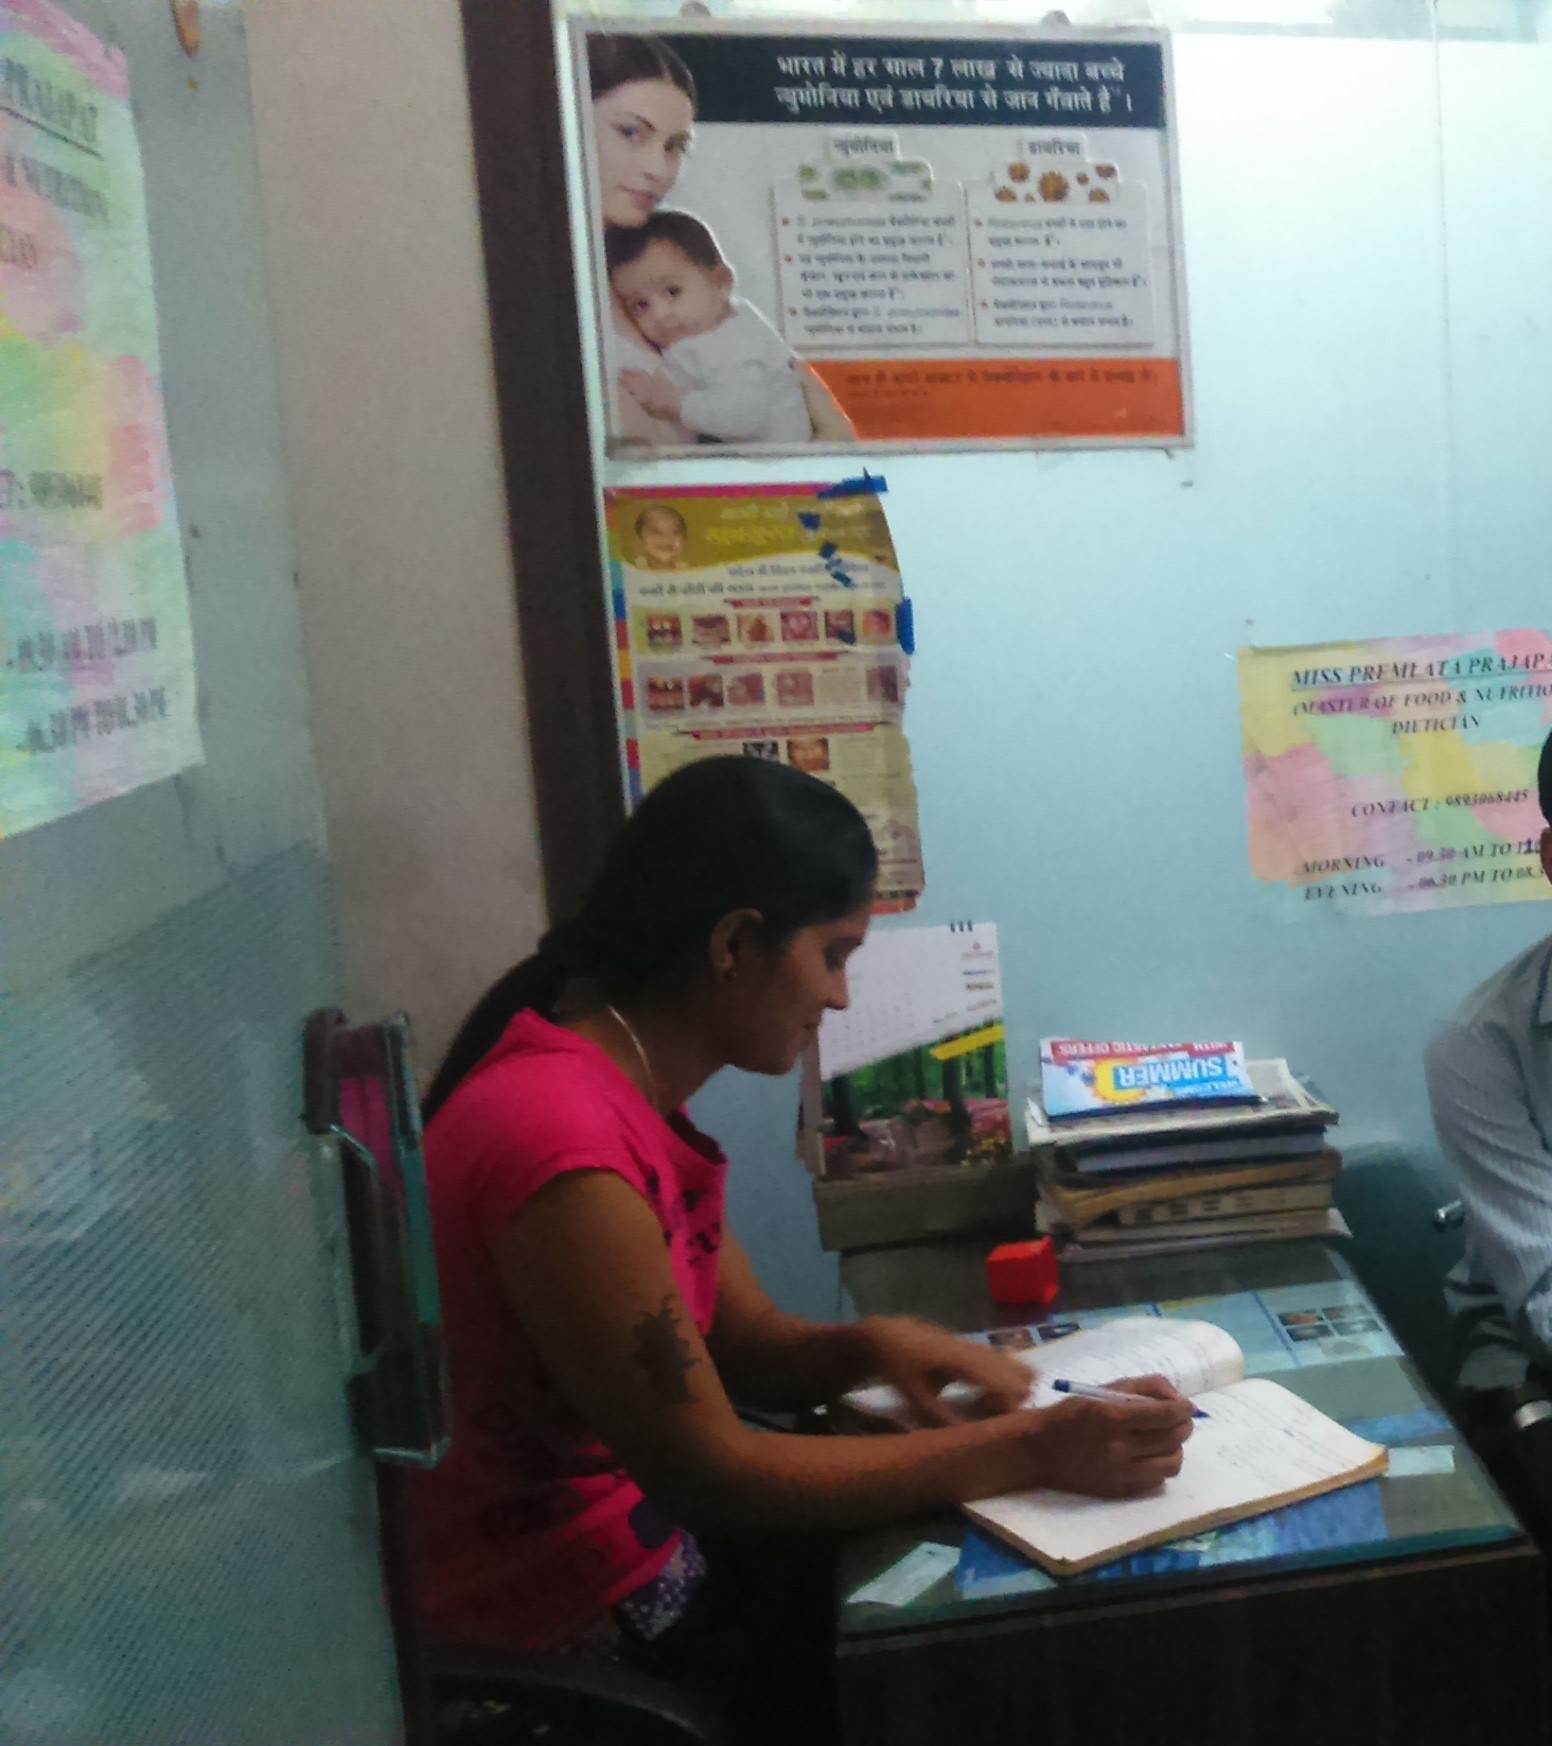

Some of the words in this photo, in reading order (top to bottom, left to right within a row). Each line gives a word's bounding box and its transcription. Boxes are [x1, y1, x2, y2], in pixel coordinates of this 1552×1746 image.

[777, 55, 826, 79] भारत
[831, 49, 847, 79] में
[853, 57, 877, 81] हर
[882, 57, 925, 79] साल
[950, 58, 996, 81] लाख
[1004, 53, 1025, 80] से
[1029, 61, 1079, 82] ज्यादा
[1084, 56, 1125, 83] बच्चे
[898, 83, 975, 110] डायरिया
[981, 82, 998, 111] से
[1002, 90, 1039, 111] जान
[1290, 666, 1344, 687] MISS
[1349, 659, 1462, 684] PREMLATA
[1293, 697, 1370, 718] (MASTER
[1374, 693, 1398, 710] OF
[1403, 690, 1451, 709] FOOD
[1455, 689, 1468, 705] &
[1392, 714, 1481, 736] DIETICIAN
[1351, 796, 1431, 818] CONTACT
[1299, 853, 1386, 875] MORNING
[1460, 843, 1486, 861] AM
[1488, 841, 1513, 859] TO
[1304, 882, 1383, 902] EVENING
[1460, 869, 1487, 887] PM
[1489, 866, 1514, 884] TO
[1117, 1057, 1223, 1088] SUMMER
